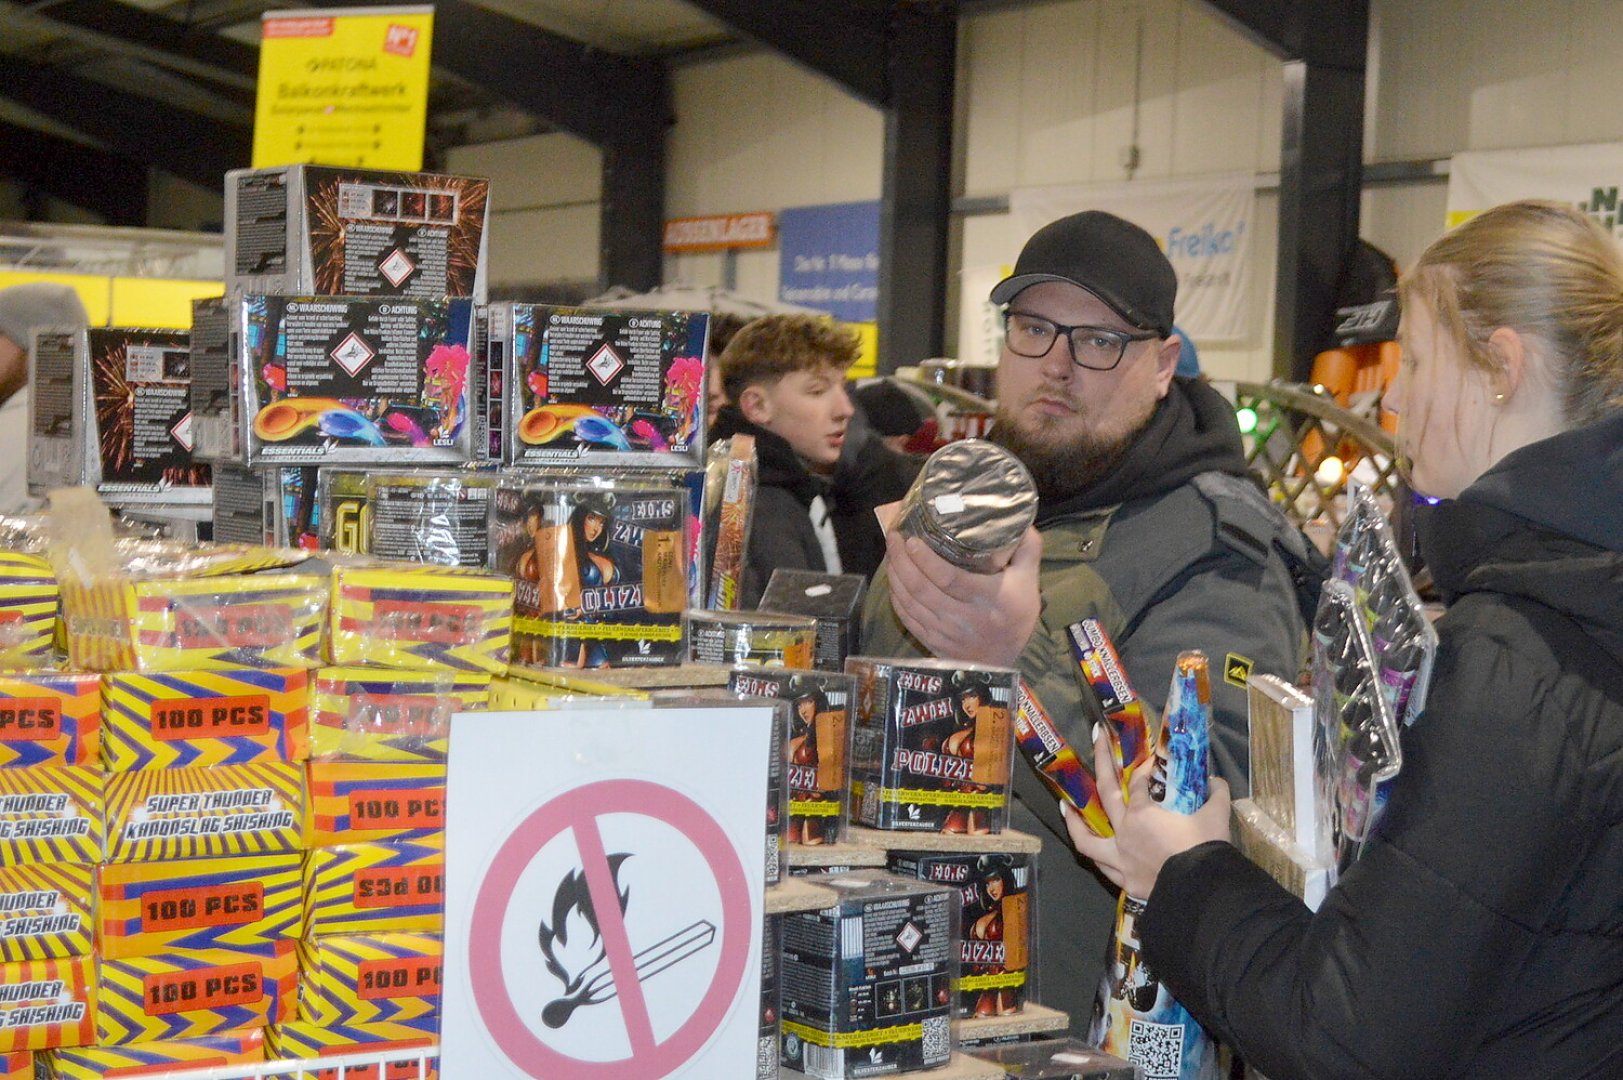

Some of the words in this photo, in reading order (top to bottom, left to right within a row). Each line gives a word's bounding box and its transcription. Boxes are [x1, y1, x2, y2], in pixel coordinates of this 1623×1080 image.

[299, 304, 348, 313] WAARSCHUWING
[391, 305, 418, 315] ACHTUNG
[561, 316, 603, 327] WAARSCHUWING
[639, 319, 662, 329] ACHTUNG
[261, 446, 326, 456] ESSENTIALS
[433, 438, 454, 447] LESLI
[524, 449, 579, 459] ESSENTIALS
[97, 484, 160, 493] ESSENTIALS
[0, 709, 54, 729] PCS
[158, 709, 204, 729] 100
[212, 706, 264, 727] PCS
[1022, 700, 1060, 753] KNALLERBSEN
[891, 748, 975, 781] POLIZE
[0, 793, 69, 813] HUNDER
[147, 794, 200, 812] SUPER
[203, 789, 273, 810] THUNDER
[355, 800, 400, 819] 100
[408, 799, 443, 818] PC
[359, 877, 409, 897] PCS
[147, 899, 197, 921] 100
[205, 893, 258, 916] PCS
[151, 982, 197, 1004] 100
[206, 973, 258, 997] PCS
[363, 968, 409, 989] 100
[0, 981, 64, 1002] HUNDER
